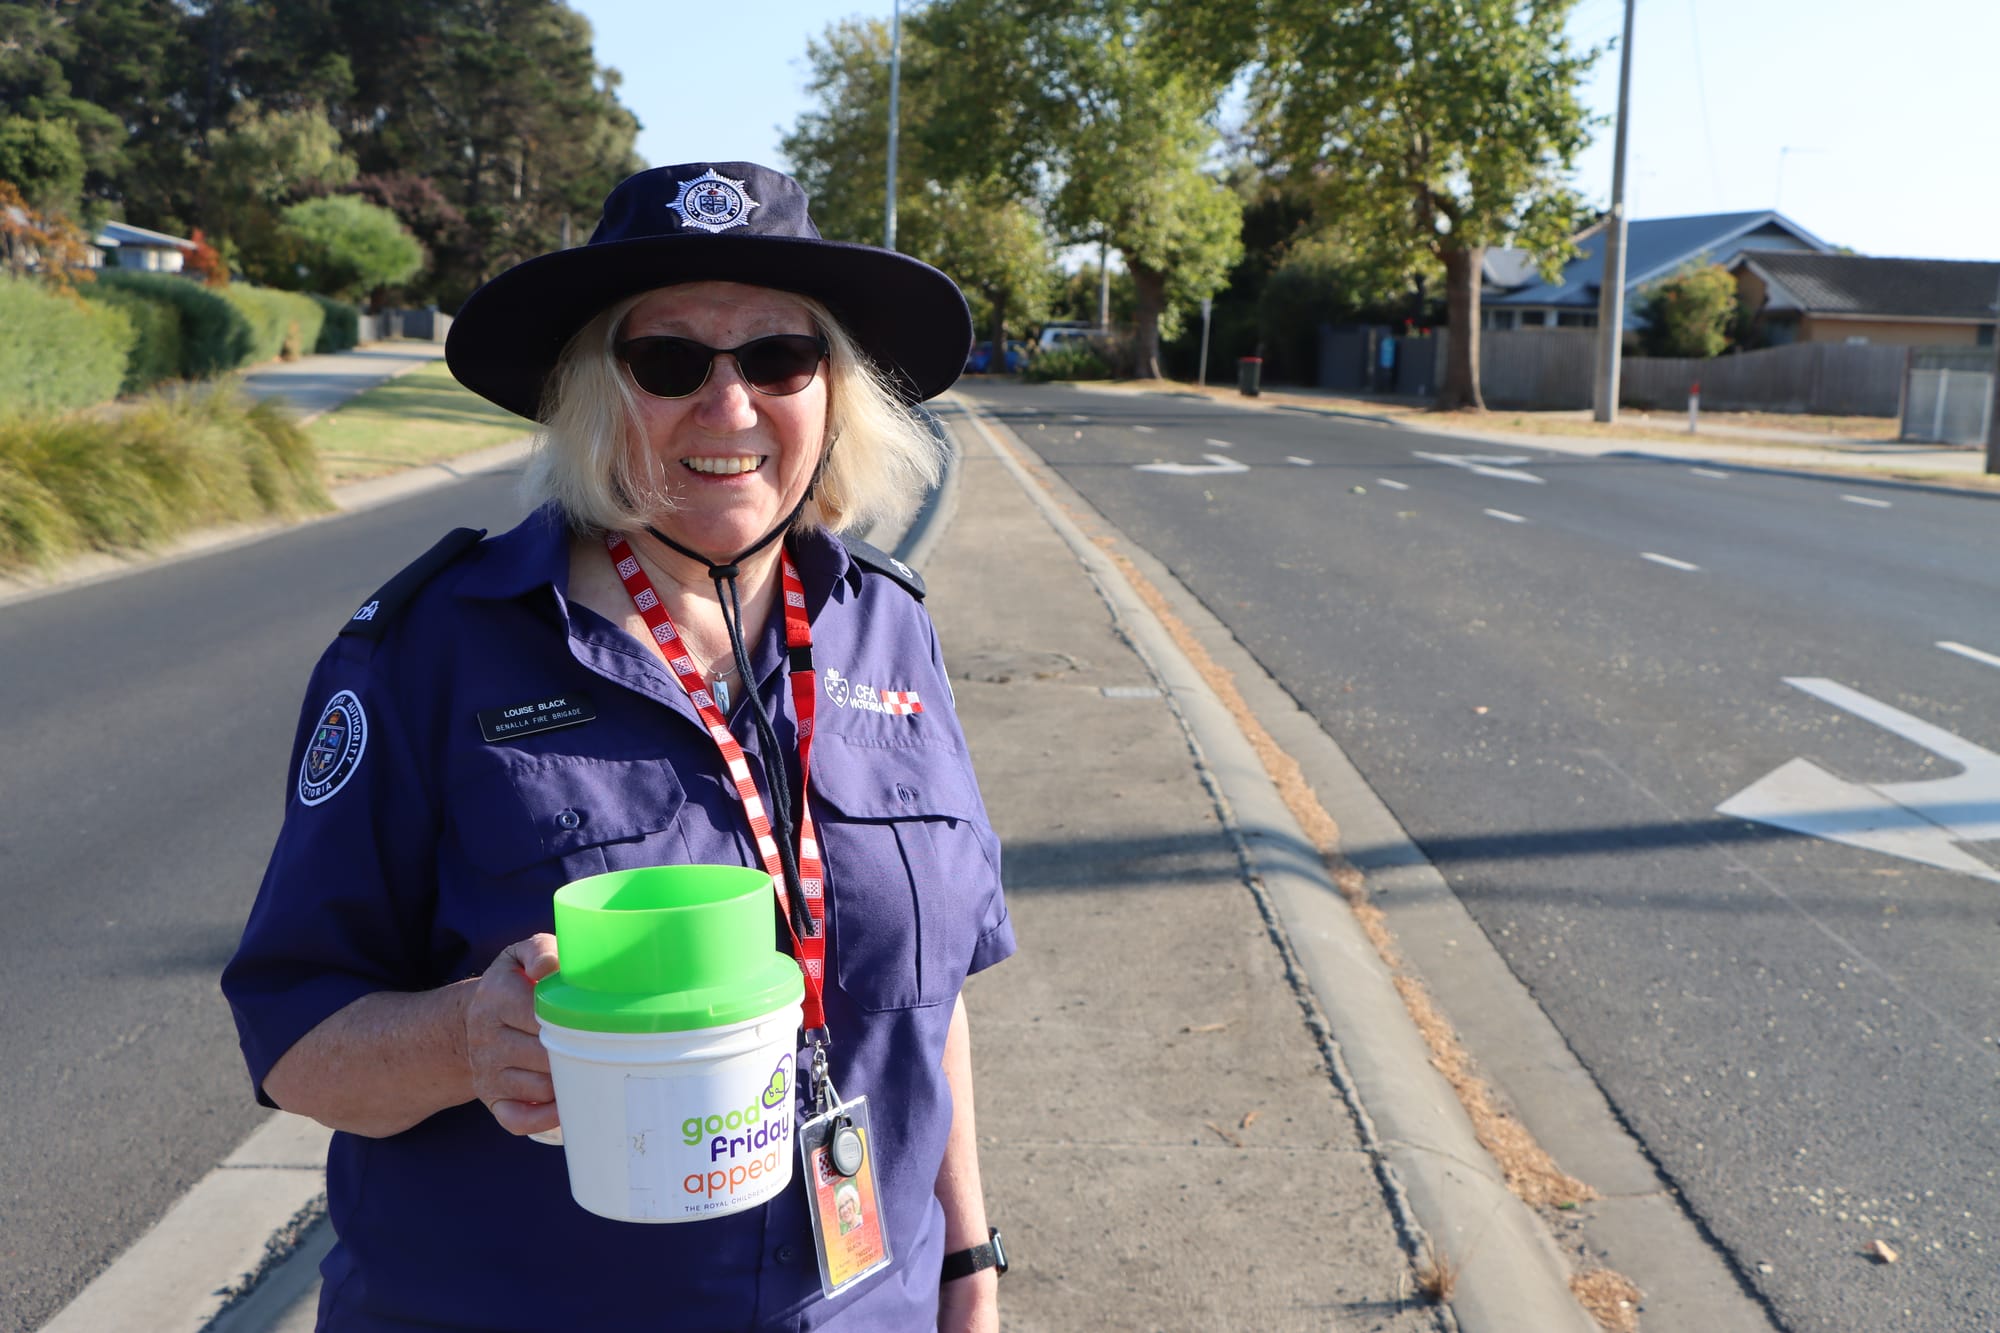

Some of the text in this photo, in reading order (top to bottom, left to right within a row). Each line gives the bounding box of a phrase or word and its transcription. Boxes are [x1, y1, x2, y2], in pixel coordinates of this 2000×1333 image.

[855, 684, 878, 702] CFA
[504, 699, 567, 718] LOUISE BLACK
[850, 697, 885, 713] VICTORIA
[495, 708, 582, 732] BENALLA FIRE BRIGADE
[346, 701, 361, 764] AUTHORITY
[302, 779, 333, 797] ICTORIA
[682, 1095, 760, 1146] good
[711, 1112, 789, 1162] friday
[683, 1141, 781, 1199] appeal
[704, 1201, 729, 1210] ROYAL
